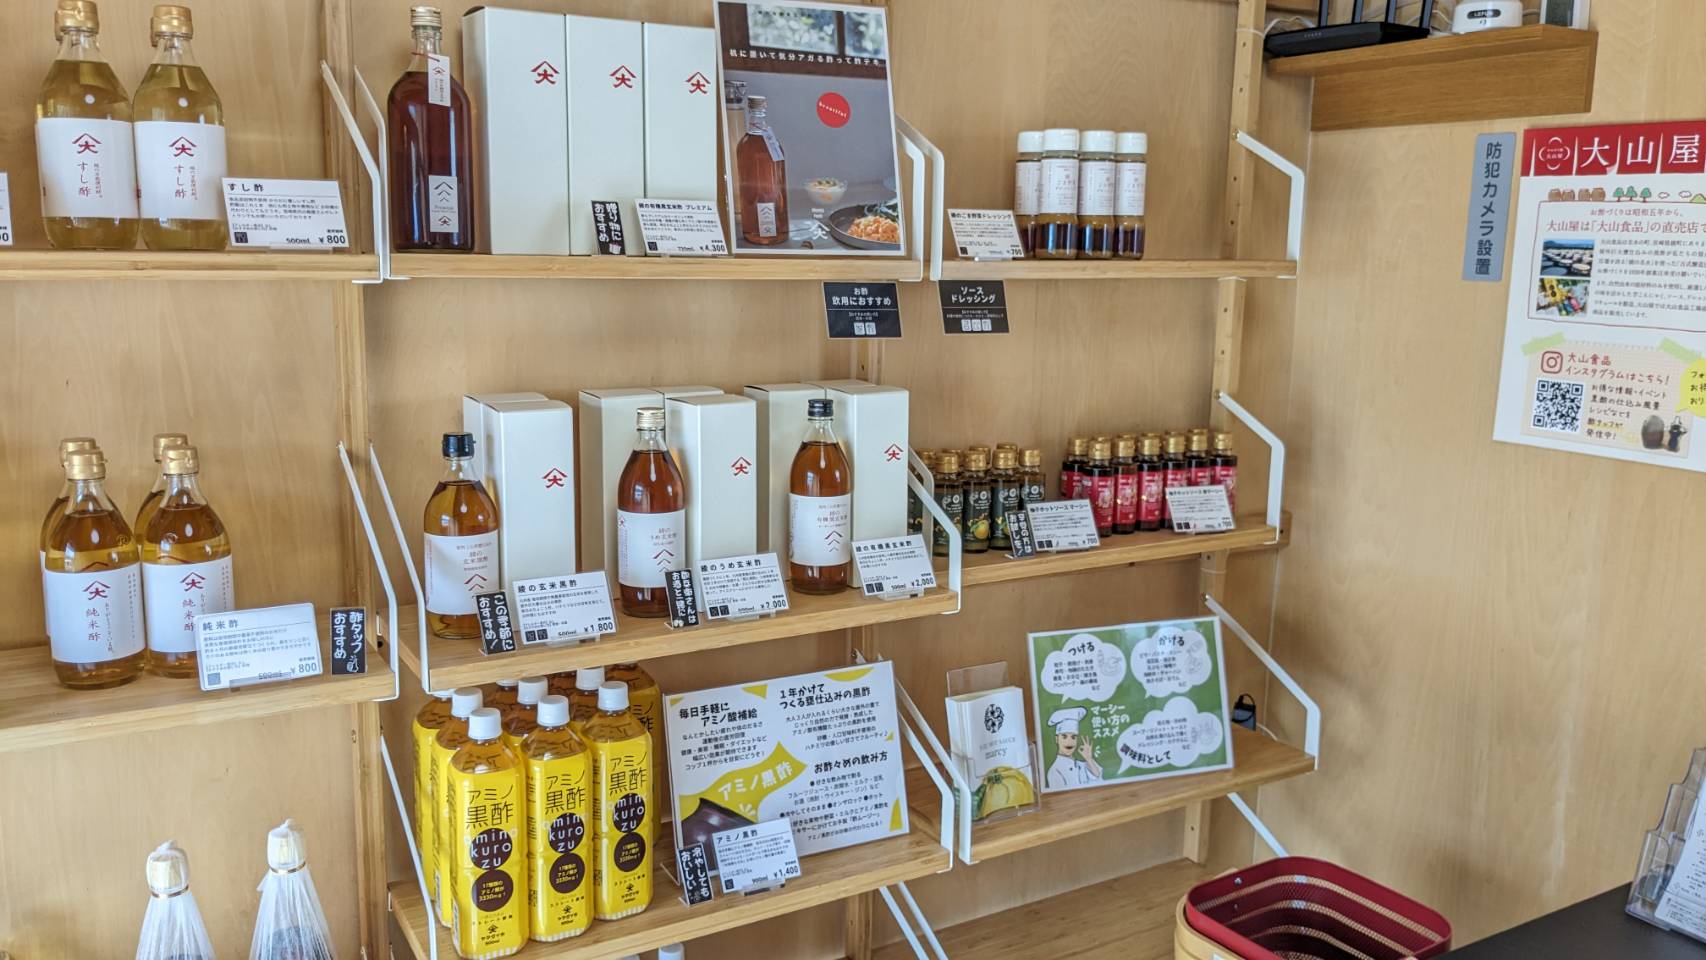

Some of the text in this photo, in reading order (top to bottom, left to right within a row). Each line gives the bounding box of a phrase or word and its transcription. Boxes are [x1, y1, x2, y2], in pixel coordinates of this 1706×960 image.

[1579, 133, 1702, 168] 大山屋
[77, 161, 92, 197] すし酢
[174, 164, 187, 199] すし酢
[228, 183, 264, 192] すし酢
[1475, 141, 1502, 276] 防犯カメラ設置
[594, 203, 609, 242] おすすめ
[853, 287, 869, 296] お酢
[951, 294, 996, 304] ドレッシング
[960, 286, 984, 295] ソース
[832, 296, 892, 306] 飲用におすすめ
[1568, 352, 1611, 366] 大山食品
[517, 579, 577, 593] 綾の玄米黒酢
[86, 607, 101, 642] 純米酢
[202, 619, 239, 631] 純米酢
[494, 594, 514, 651] この季節に
[334, 613, 347, 660] おすすめ
[1158, 635, 1185, 647] かける
[1067, 641, 1095, 657] つける
[779, 687, 871, 709] つくる甕仕込みの黒酢
[679, 702, 730, 719] 毎日手軽に
[700, 708, 758, 727] アミノ酸補給
[1090, 703, 1126, 715] マーシー
[1091, 714, 1130, 728] 使い方の
[1092, 726, 1120, 739] ススメ
[610, 751, 648, 771] アミノ
[814, 751, 888, 774] お酢々めの飲み方
[1119, 744, 1171, 765] 調味料として
[545, 770, 585, 791] アミノ
[609, 768, 648, 796] 黒酢
[718, 761, 793, 801] アミノ黒酢
[467, 784, 513, 804] アミノ
[545, 787, 586, 815] 黒酢
[466, 801, 514, 830] 黒酢
[613, 805, 645, 821] kuro
[548, 825, 584, 841] kuro
[621, 820, 637, 832] zu
[716, 829, 758, 844] アミノ黒酢
[471, 841, 512, 858] kuro
[557, 841, 575, 852] zu
[482, 857, 502, 869] zu
[681, 850, 697, 890] おいしい
[692, 847, 710, 897] 冷やしても
